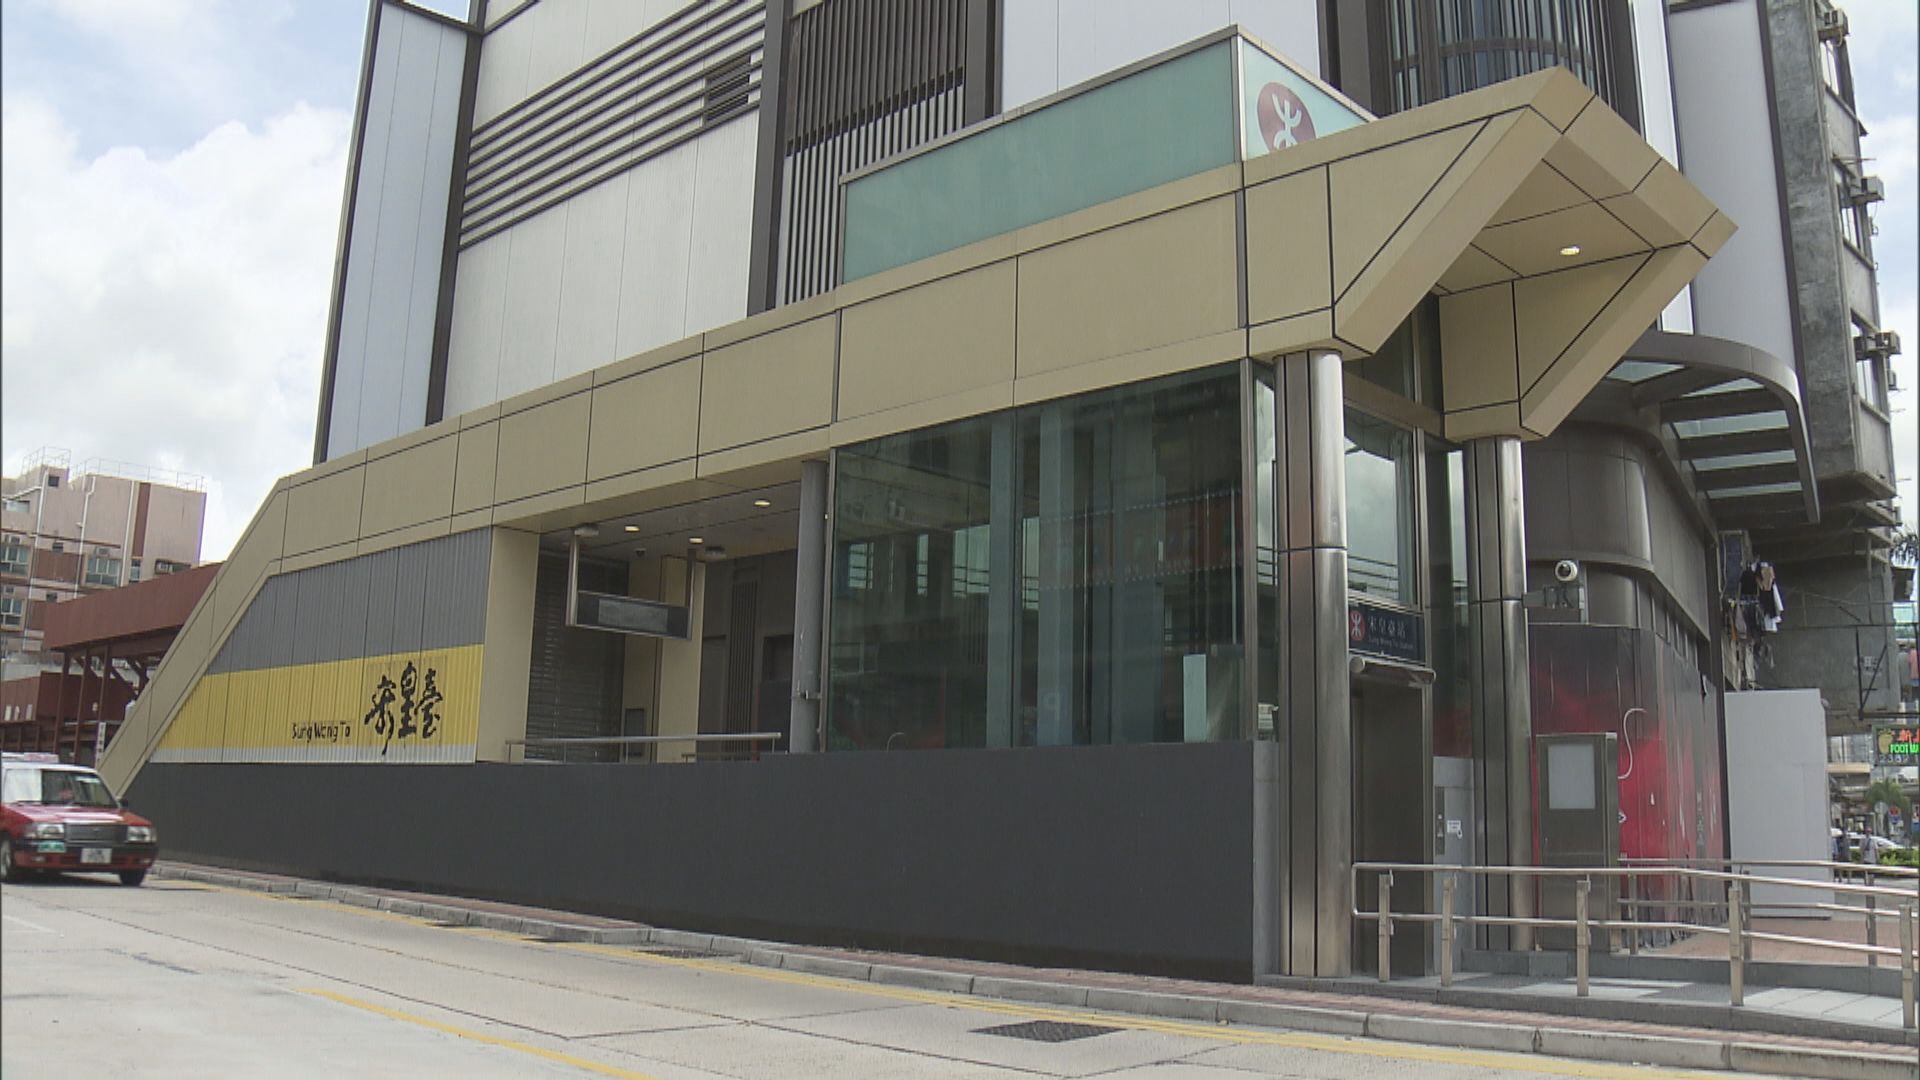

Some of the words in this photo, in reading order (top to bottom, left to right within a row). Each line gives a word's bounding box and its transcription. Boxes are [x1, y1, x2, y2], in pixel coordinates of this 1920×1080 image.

[364, 660, 443, 755] 宋皇臺
[292, 722, 312, 743] Sung
[314, 721, 338, 743] Wong
[339, 721, 350, 737] To
[1890, 743, 1909, 753] FOOT
